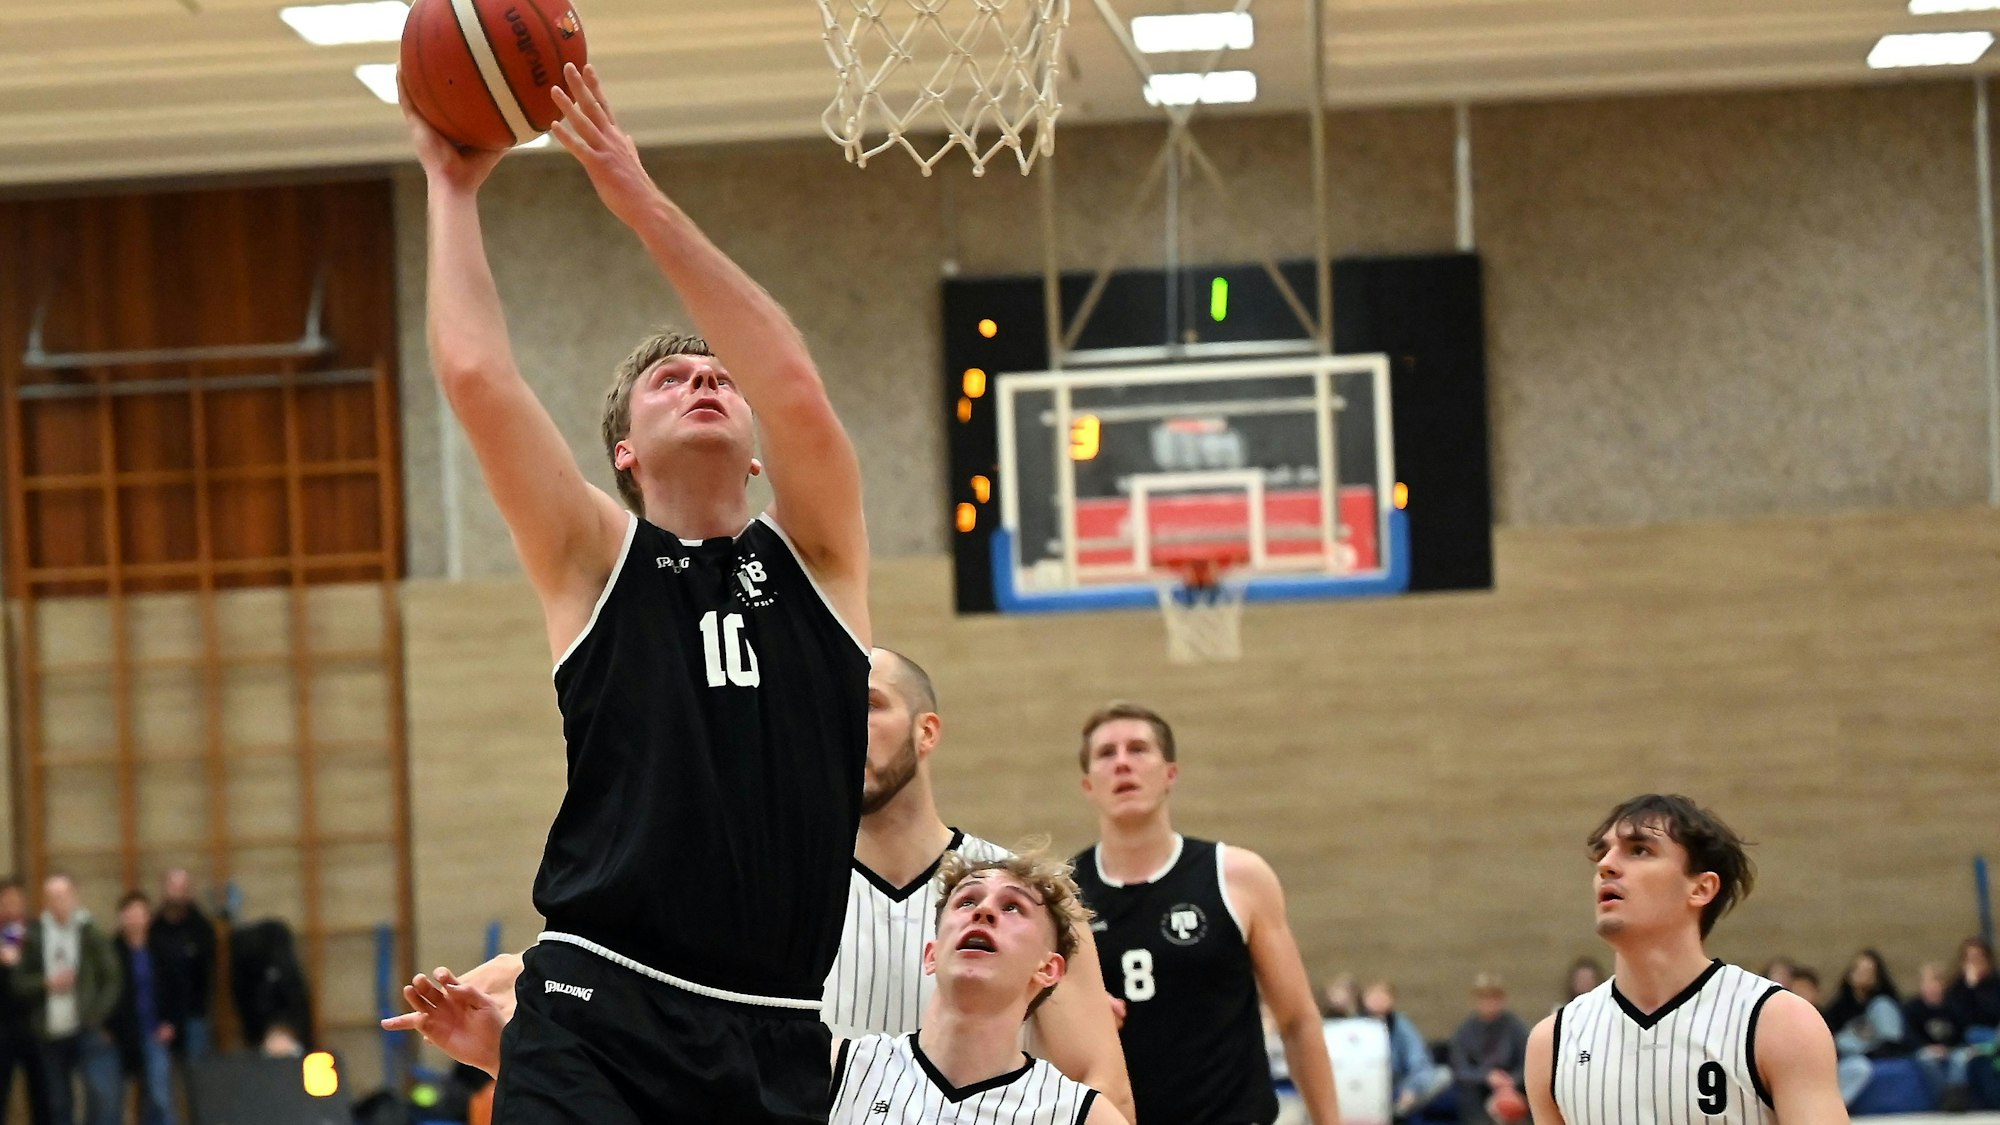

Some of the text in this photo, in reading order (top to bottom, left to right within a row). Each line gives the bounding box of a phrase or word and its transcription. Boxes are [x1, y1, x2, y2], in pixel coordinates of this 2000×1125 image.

[505, 6, 548, 87] molten
[699, 611, 761, 688] 10
[544, 980, 594, 1001] SPALDING
[1121, 948, 1156, 1002] 8
[302, 1051, 339, 1097] 6
[1697, 1061, 1727, 1115] 9
